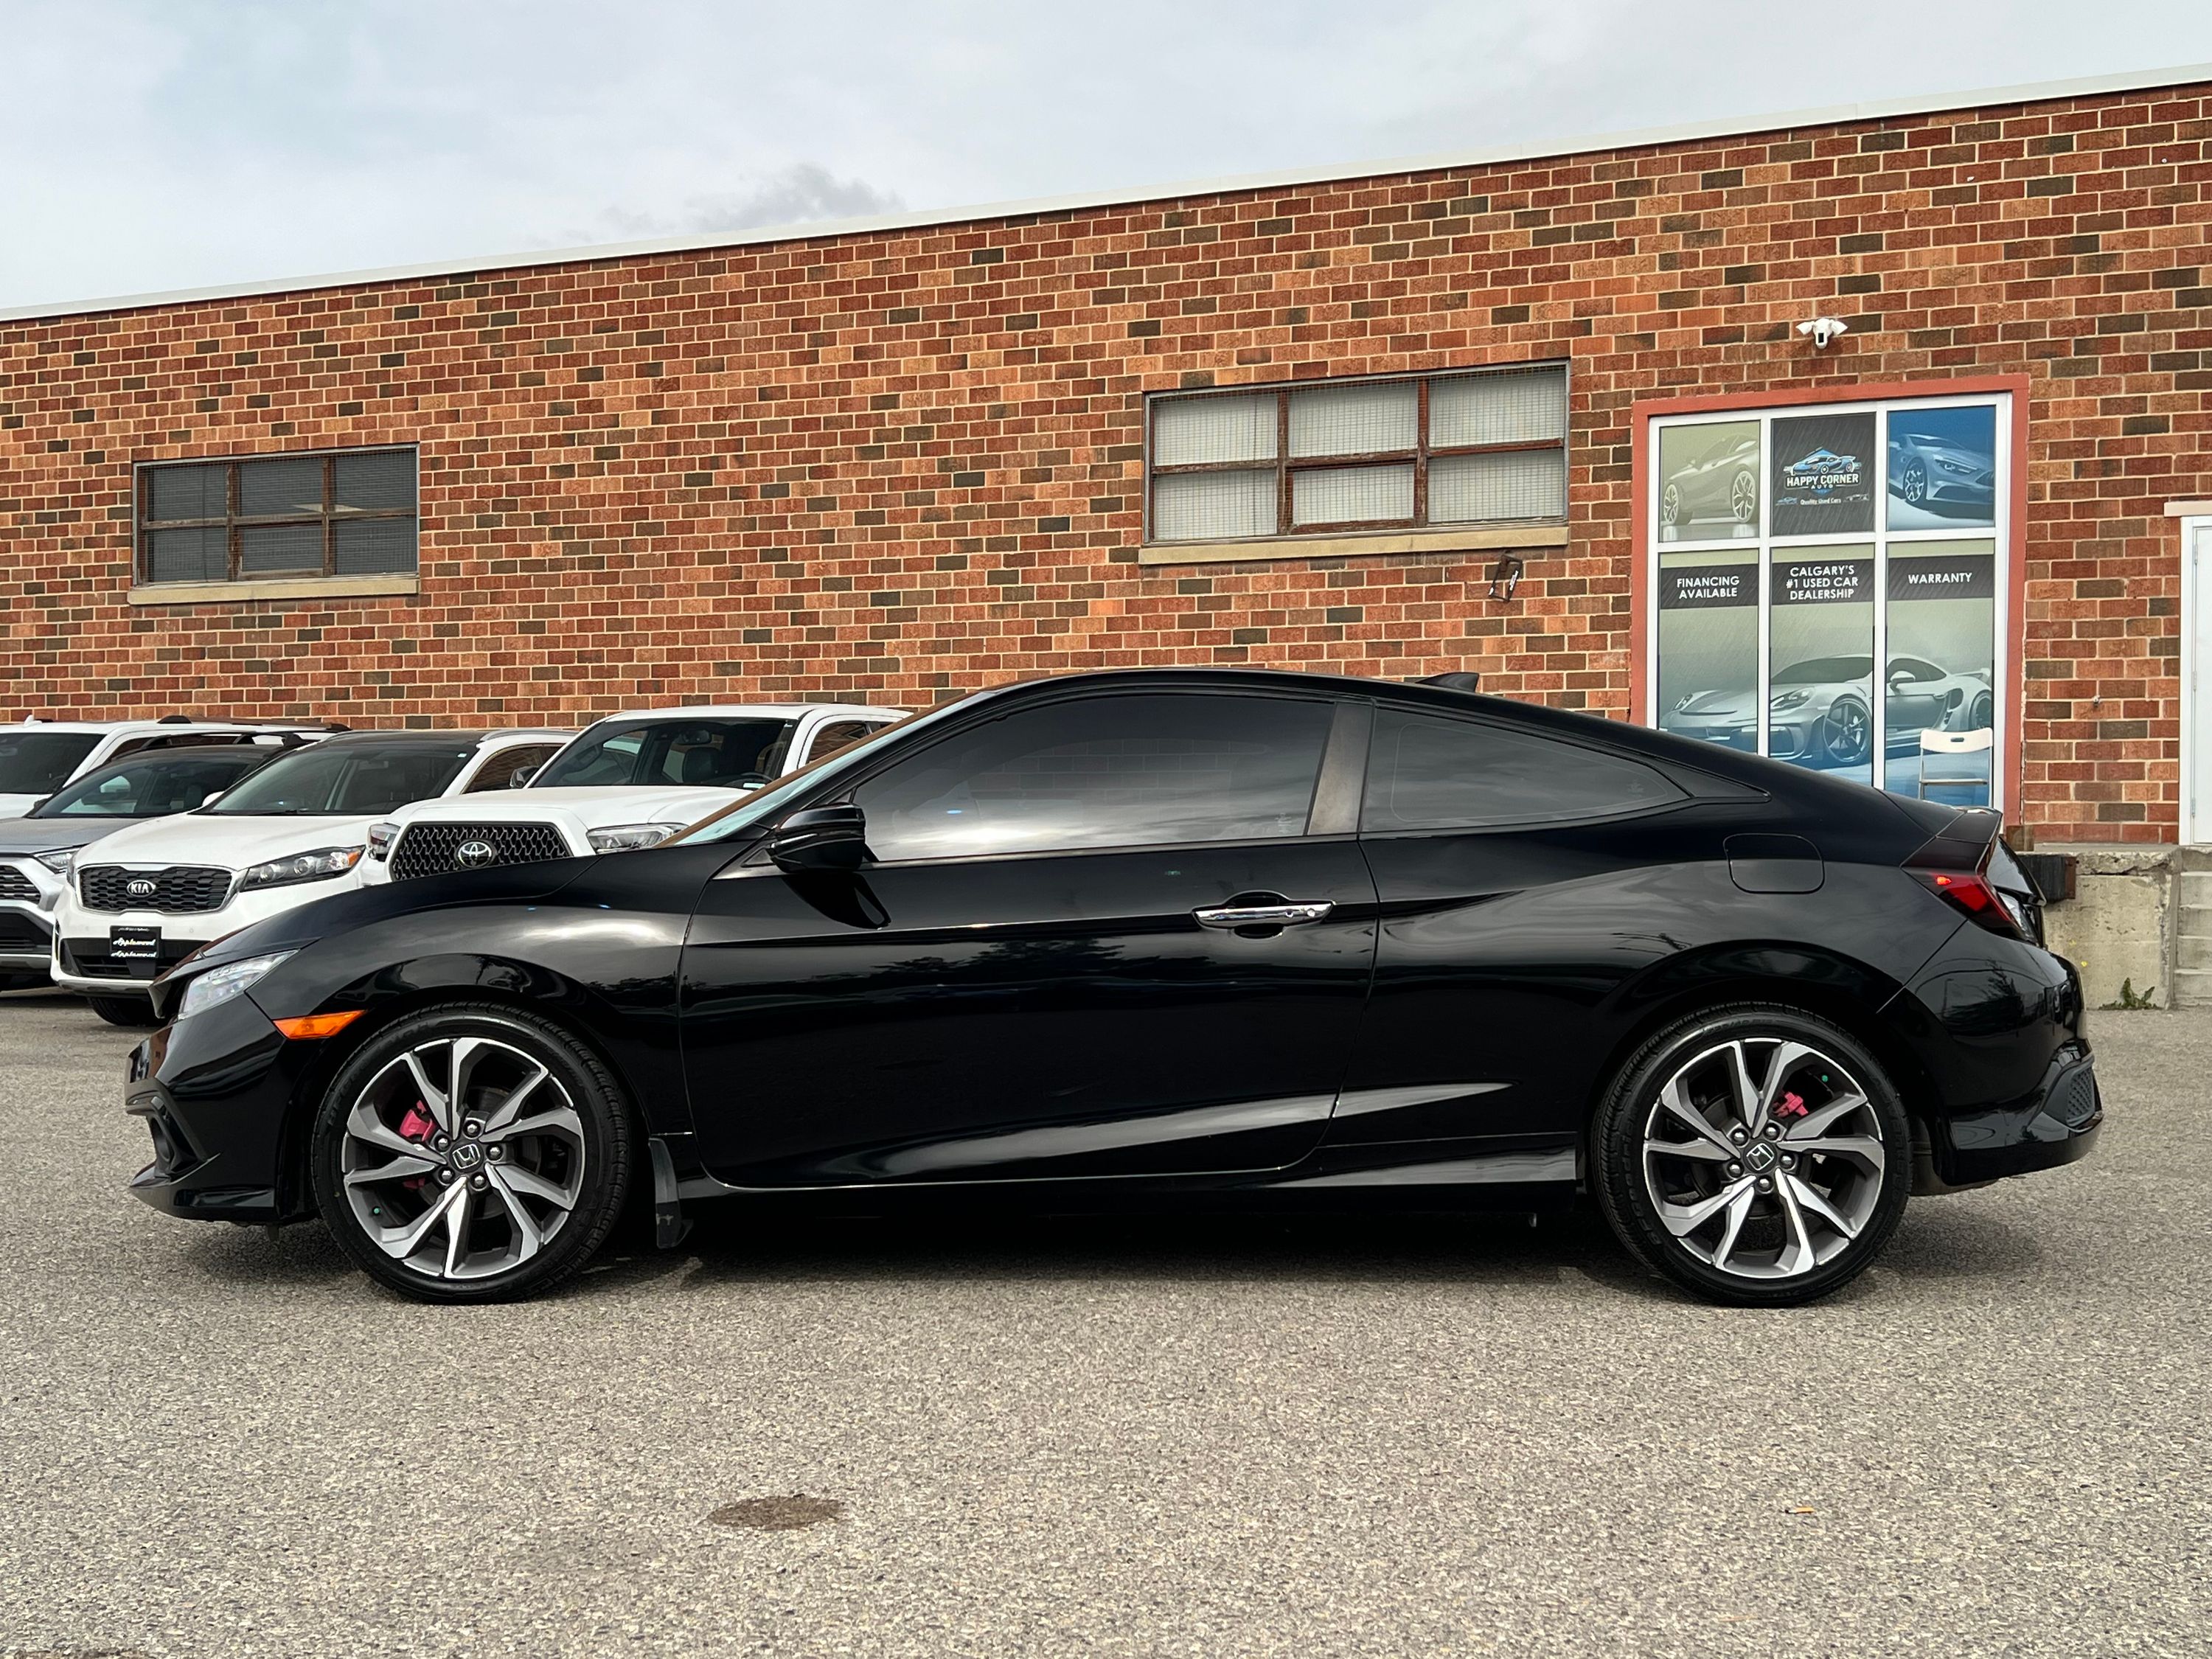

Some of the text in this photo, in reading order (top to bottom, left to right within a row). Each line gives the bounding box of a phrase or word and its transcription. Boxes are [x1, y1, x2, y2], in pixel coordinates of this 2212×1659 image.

[1787, 473, 1859, 487] HAPPY CORNER
[1790, 565, 1854, 577] CALGARY'S
[1677, 576, 1739, 588] FINANCING
[1786, 577, 1858, 588] #1 USED CAR
[1907, 572, 1972, 584] WARRANTY
[1679, 588, 1738, 599] AVAILABLE
[1790, 588, 1854, 600] DEALERSHIP
[131, 883, 149, 894] KIA
